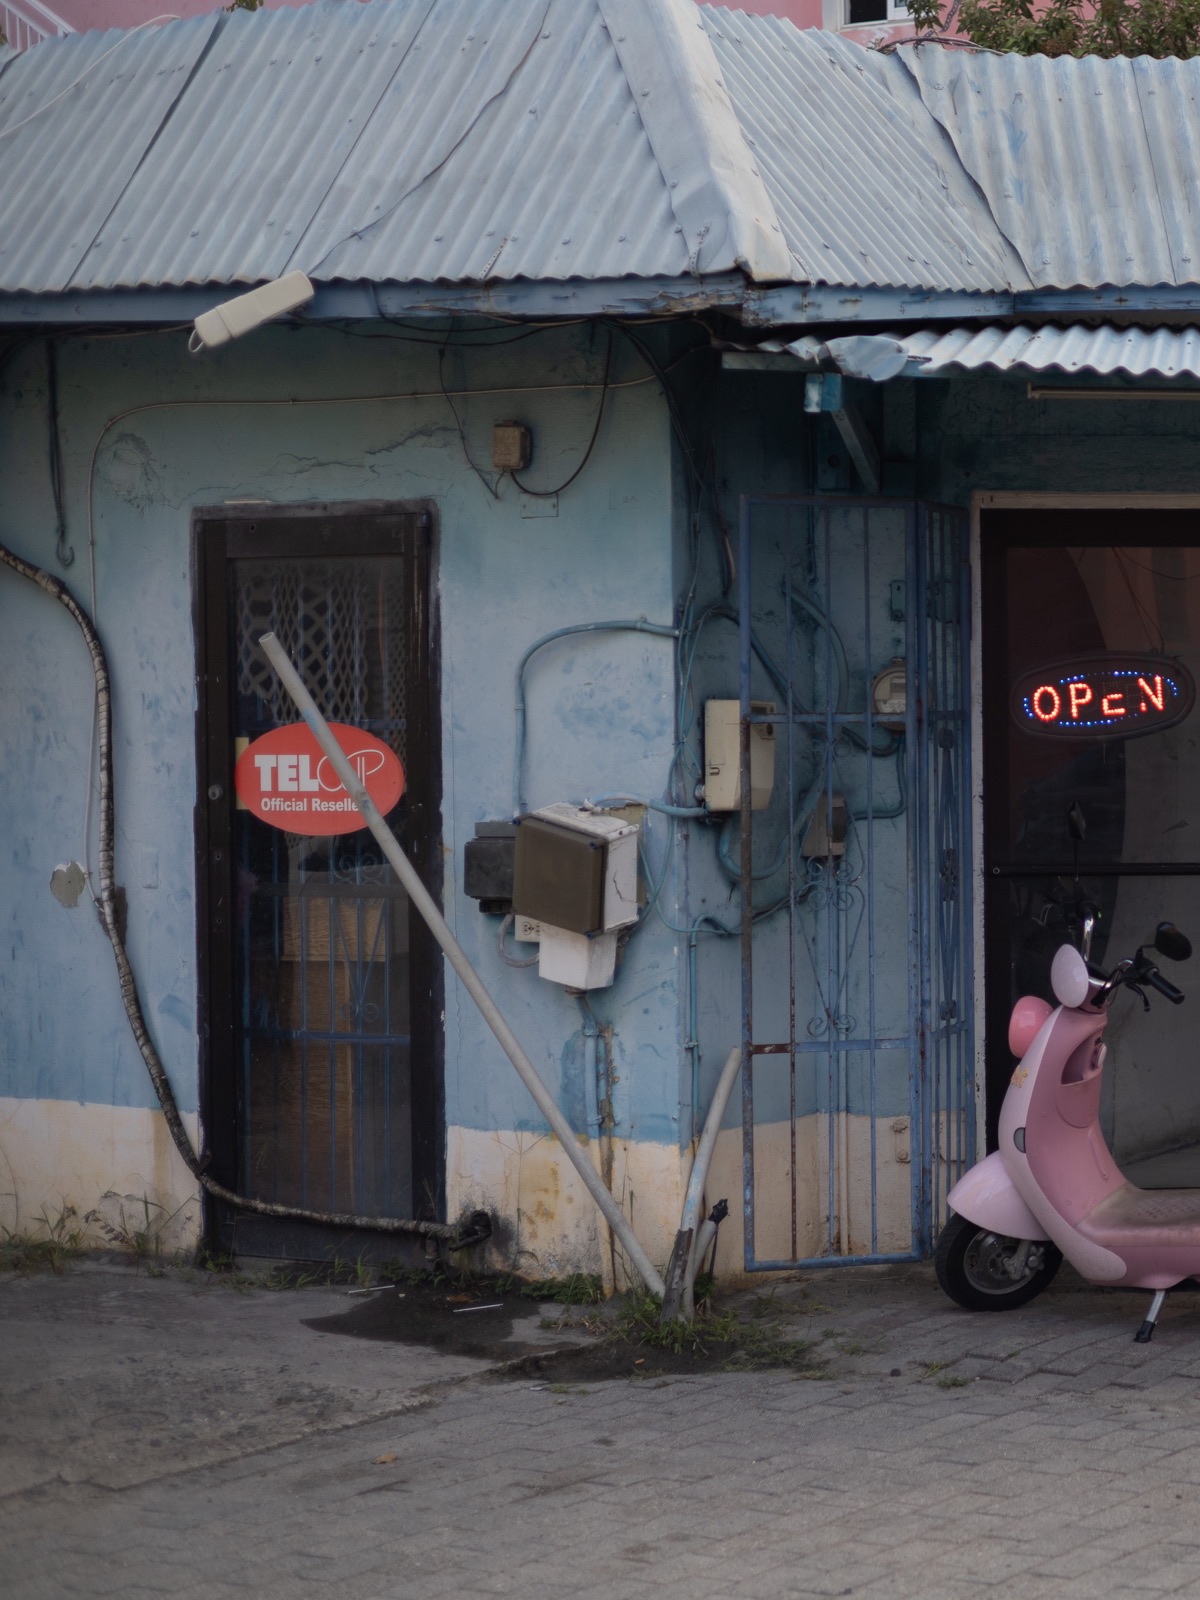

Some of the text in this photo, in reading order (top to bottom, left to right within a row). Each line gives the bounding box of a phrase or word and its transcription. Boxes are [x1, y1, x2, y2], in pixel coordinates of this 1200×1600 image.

[1033, 675, 1165, 721] OPEN
[261, 797, 360, 812] Official Reselle
